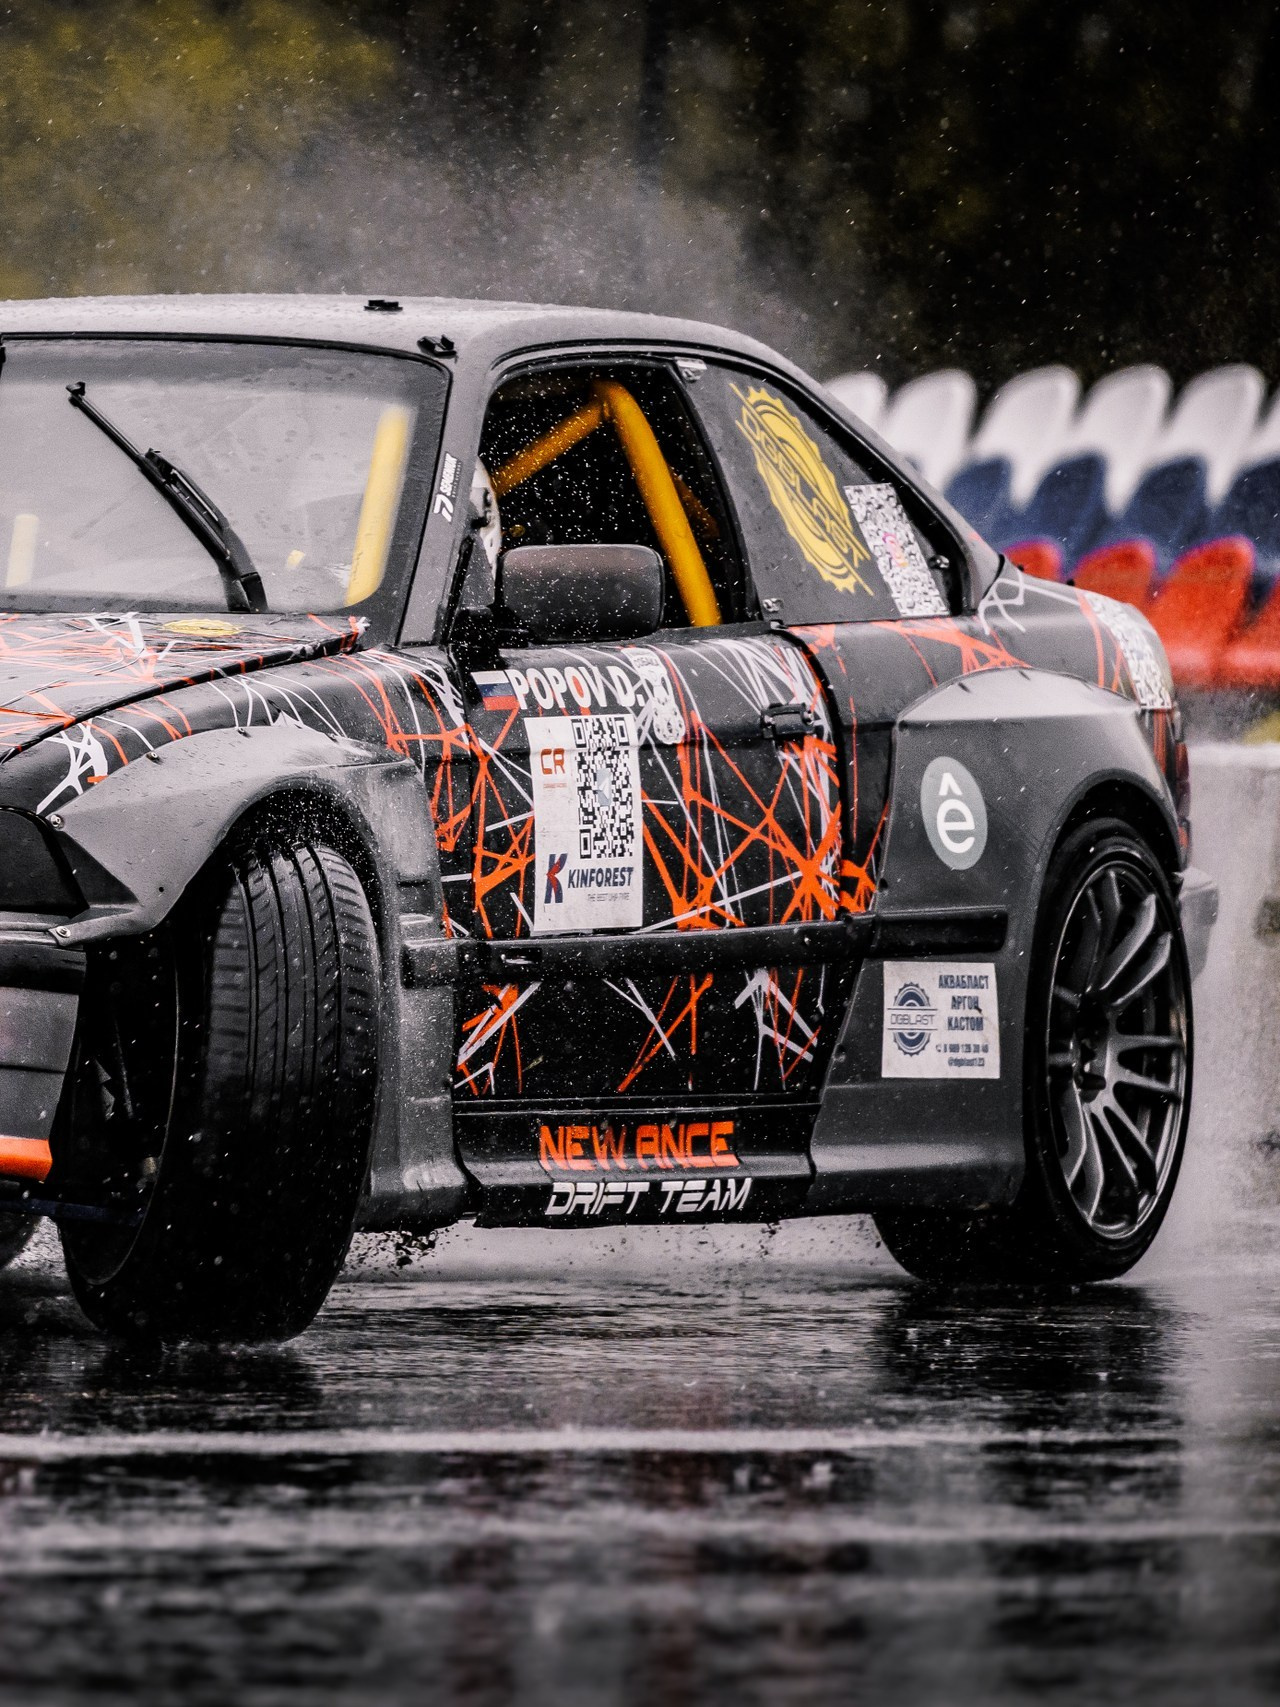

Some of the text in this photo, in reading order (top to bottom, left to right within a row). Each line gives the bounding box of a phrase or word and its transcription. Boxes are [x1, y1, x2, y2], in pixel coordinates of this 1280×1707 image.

[505, 665, 645, 709] POPOV D.
[541, 748, 565, 775] CR
[567, 866, 634, 889] KINFOREST
[938, 974, 989, 989] АКВАБЛАСТ
[951, 995, 980, 1011] АРГОН
[890, 1013, 935, 1026] DGBLAST
[947, 1016, 984, 1031] КАСТОМ
[539, 1120, 740, 1171] NEW ANCE
[545, 1177, 753, 1215] DRIFT TEAM
